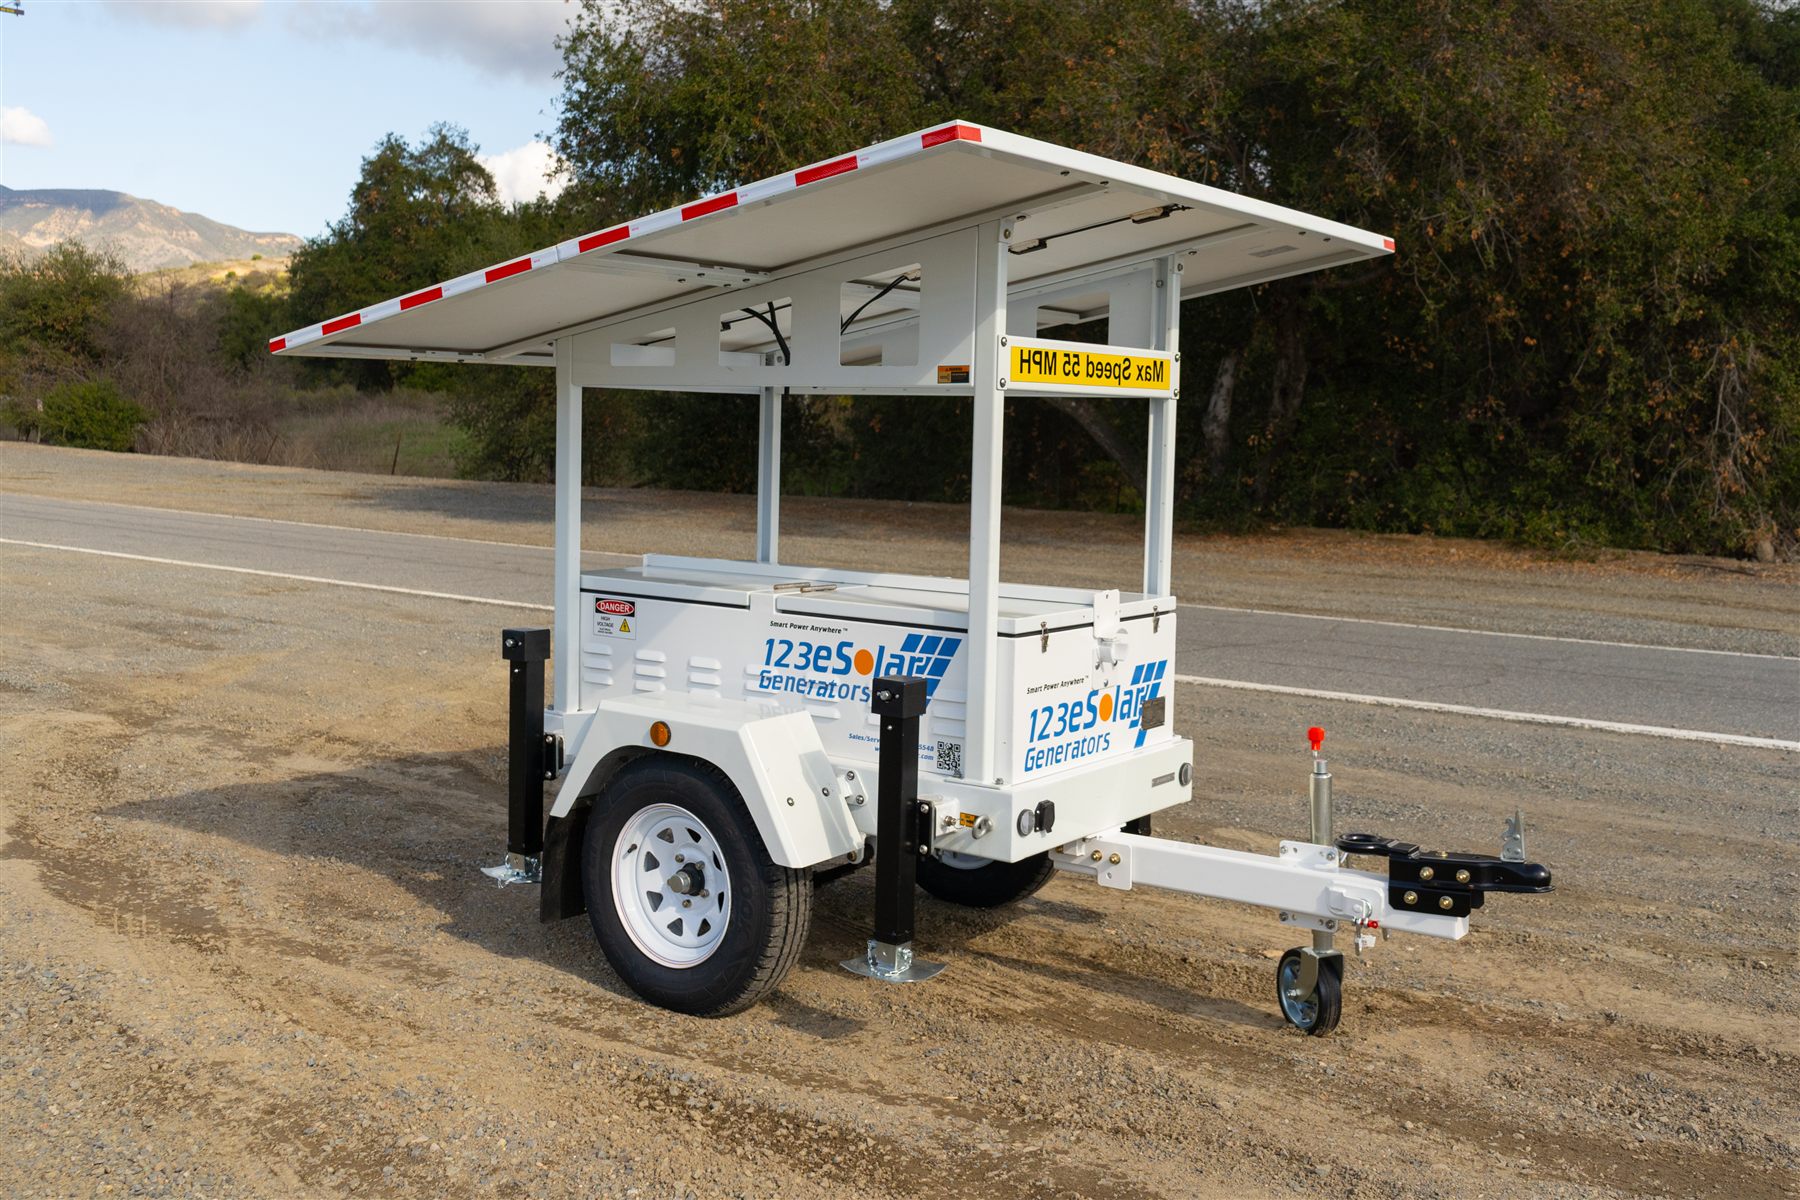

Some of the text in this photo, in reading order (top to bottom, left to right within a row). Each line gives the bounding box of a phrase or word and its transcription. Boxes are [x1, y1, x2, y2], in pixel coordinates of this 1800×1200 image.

[600, 602, 630, 613] DANGER
[770, 620, 788, 629] Smart
[789, 622, 809, 631] Power
[810, 625, 842, 634] Anywhere
[759, 669, 871, 703] Generators
[1026, 686, 1043, 694] Smart
[1043, 682, 1060, 691] Power
[1060, 677, 1085, 688] Anywhere
[848, 732, 880, 743] Sales/Serv
[1024, 731, 1111, 773] Generators
